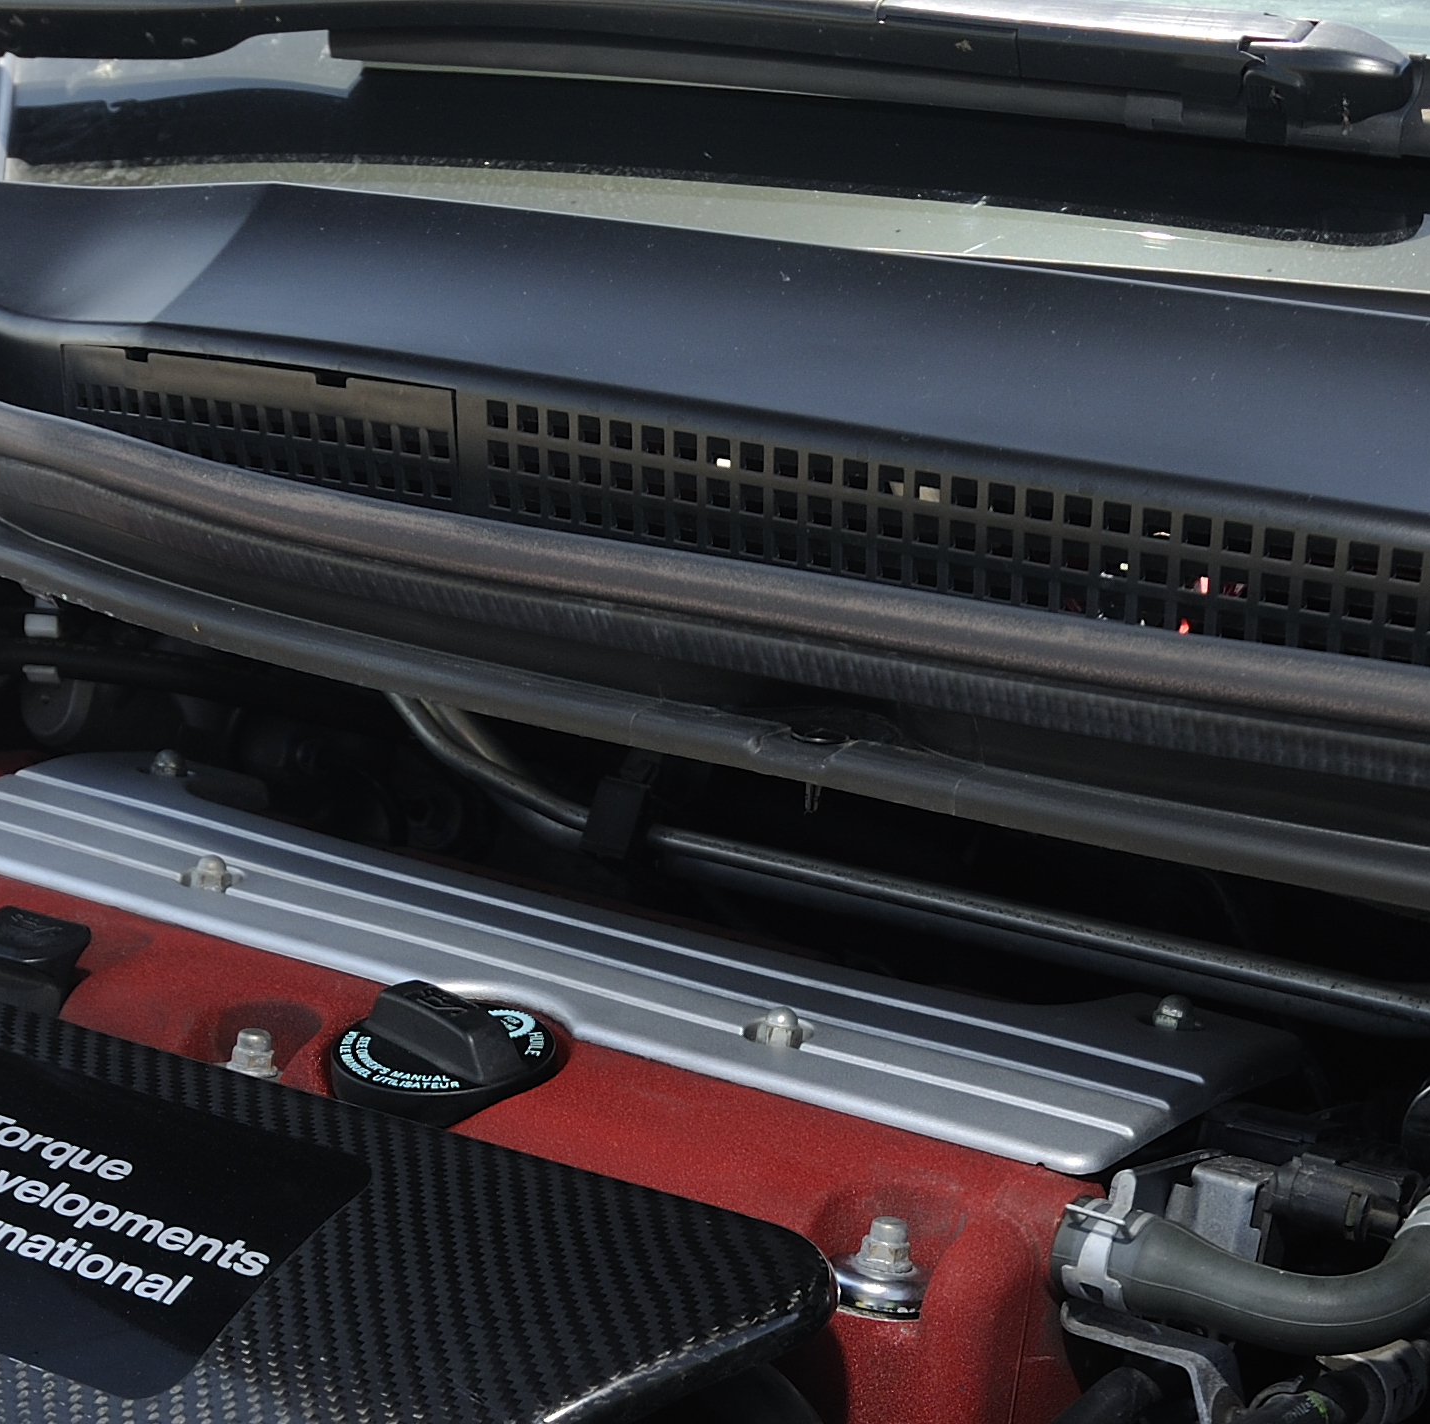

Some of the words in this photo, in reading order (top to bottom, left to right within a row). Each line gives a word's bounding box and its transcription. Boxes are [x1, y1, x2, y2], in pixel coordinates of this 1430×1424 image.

[356, 1036, 371, 1049] SEE
[389, 1071, 451, 1082] MANUAL
[372, 1074, 460, 1089] UTILISATEUR
